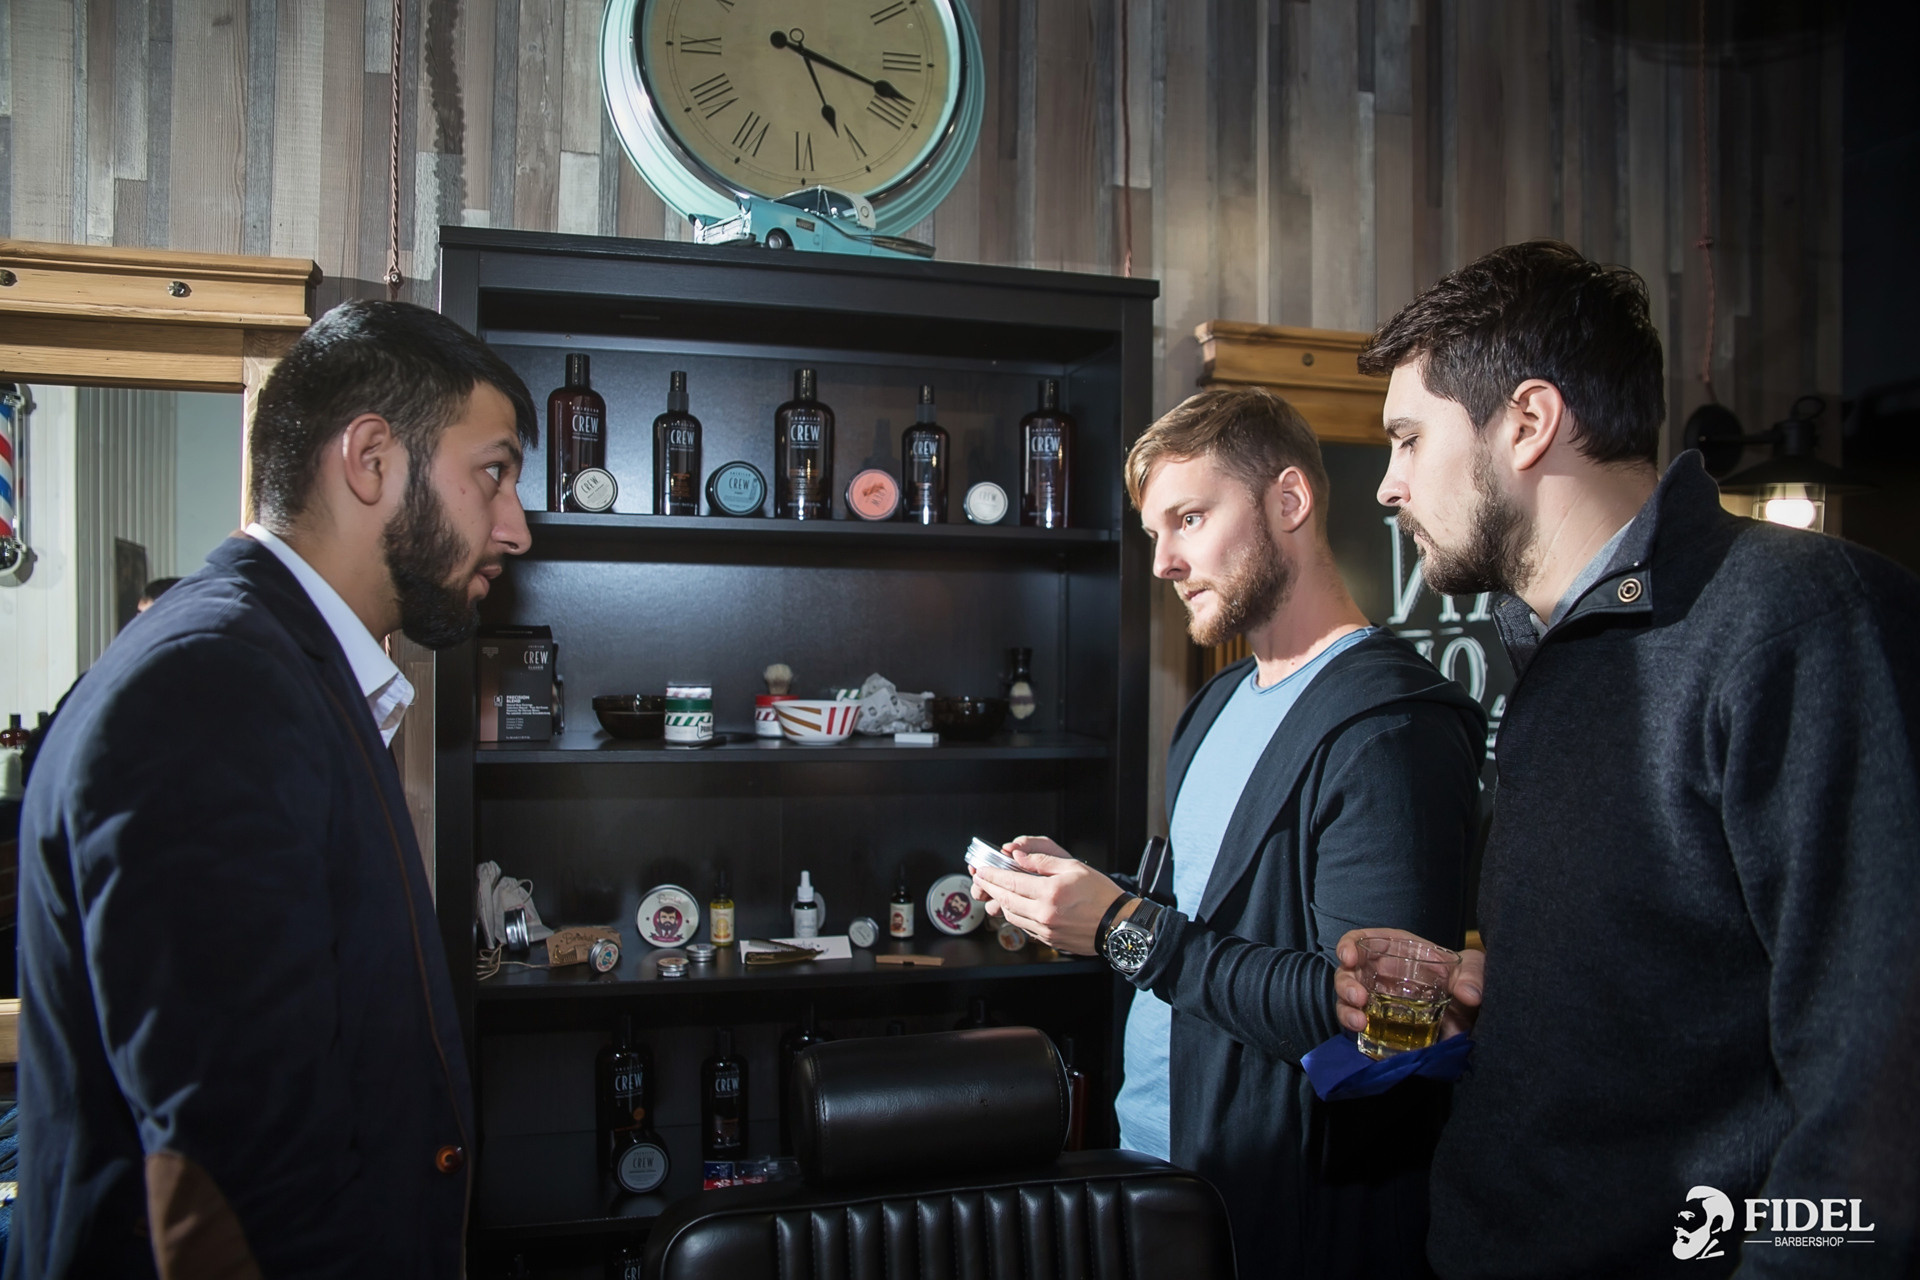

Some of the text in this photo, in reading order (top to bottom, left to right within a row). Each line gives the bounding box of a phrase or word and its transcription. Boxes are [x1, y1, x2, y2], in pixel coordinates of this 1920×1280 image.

[572, 414, 599, 433] CREW
[670, 429, 695, 445] CREW
[790, 424, 820, 441] CREW
[912, 440, 938, 455] CREW
[1031, 436, 1061, 452] CREW
[580, 475, 599, 494] CREW
[728, 477, 750, 490] CREW
[523, 650, 549, 665] CREW
[614, 1072, 643, 1092] CREW
[715, 1076, 740, 1093] CREW
[632, 1156, 654, 1169] CREW
